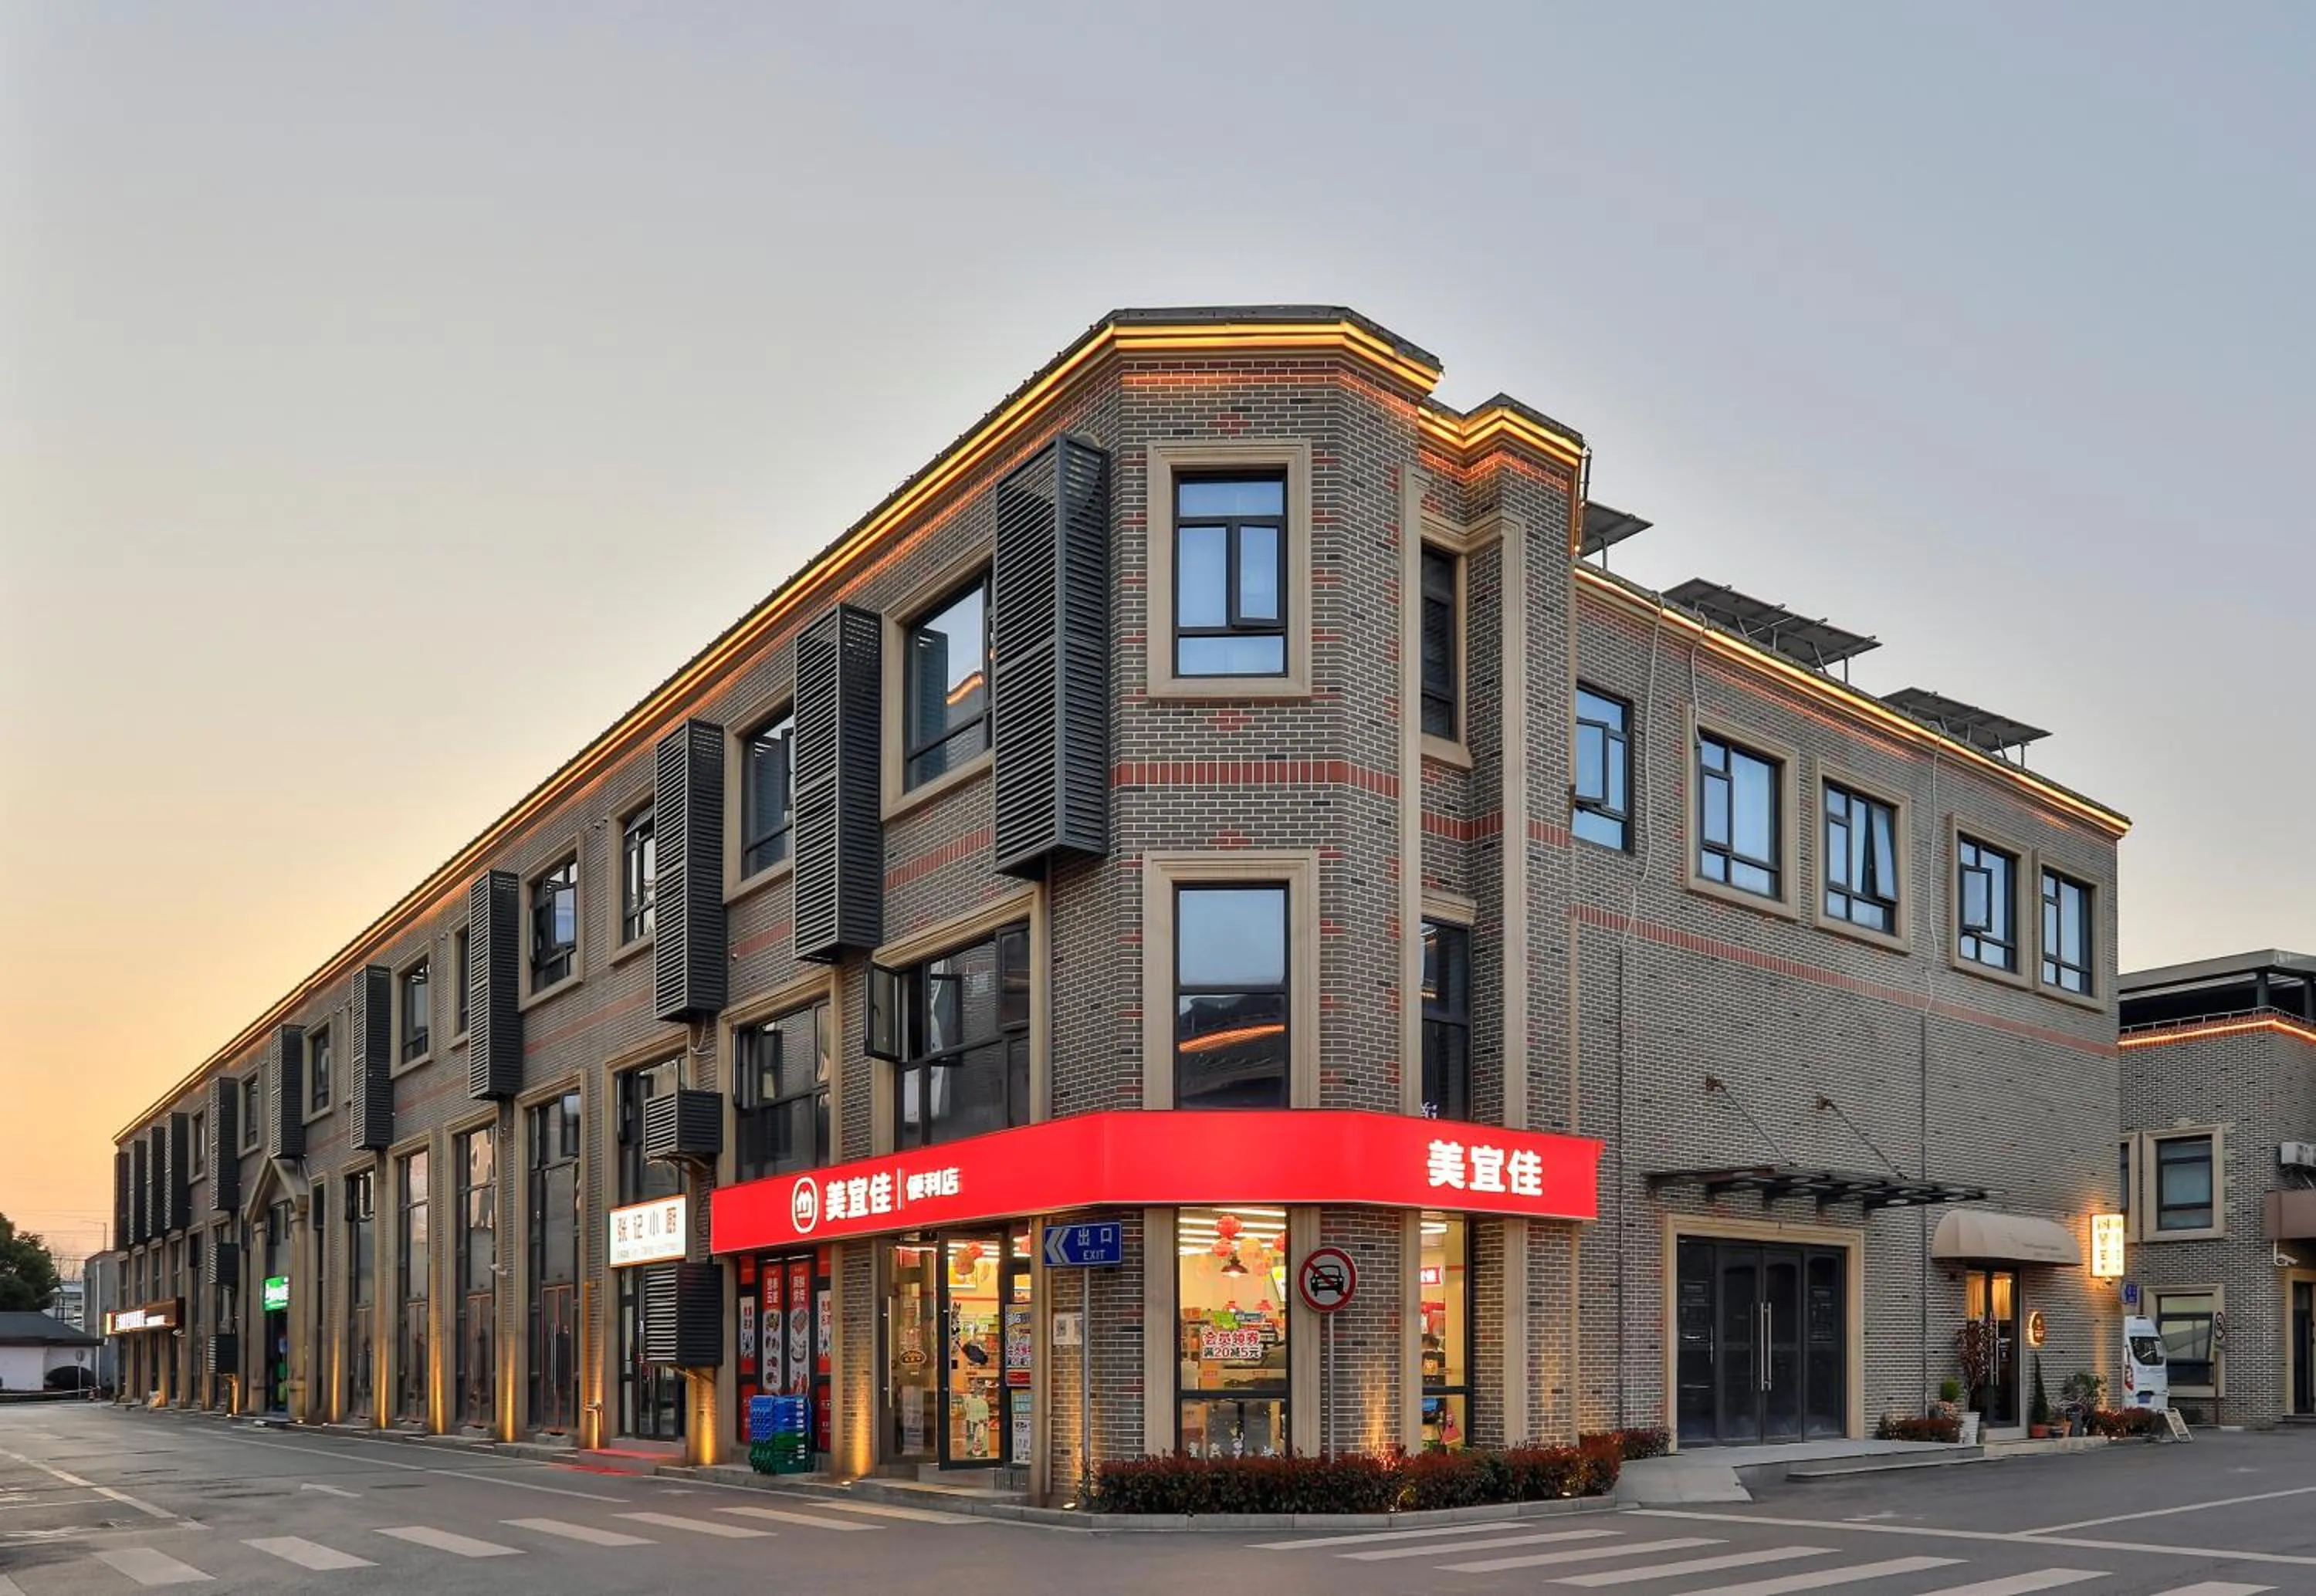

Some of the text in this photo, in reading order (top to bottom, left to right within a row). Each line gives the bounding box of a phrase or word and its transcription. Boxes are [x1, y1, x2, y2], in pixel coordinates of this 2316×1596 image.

[1427, 1139, 1543, 1196] 美宜佳
[825, 1167, 960, 1222] 美宜佳 便利店
[1077, 1228, 1112, 1246] 出口
[1083, 1249, 1106, 1260] EXIT
